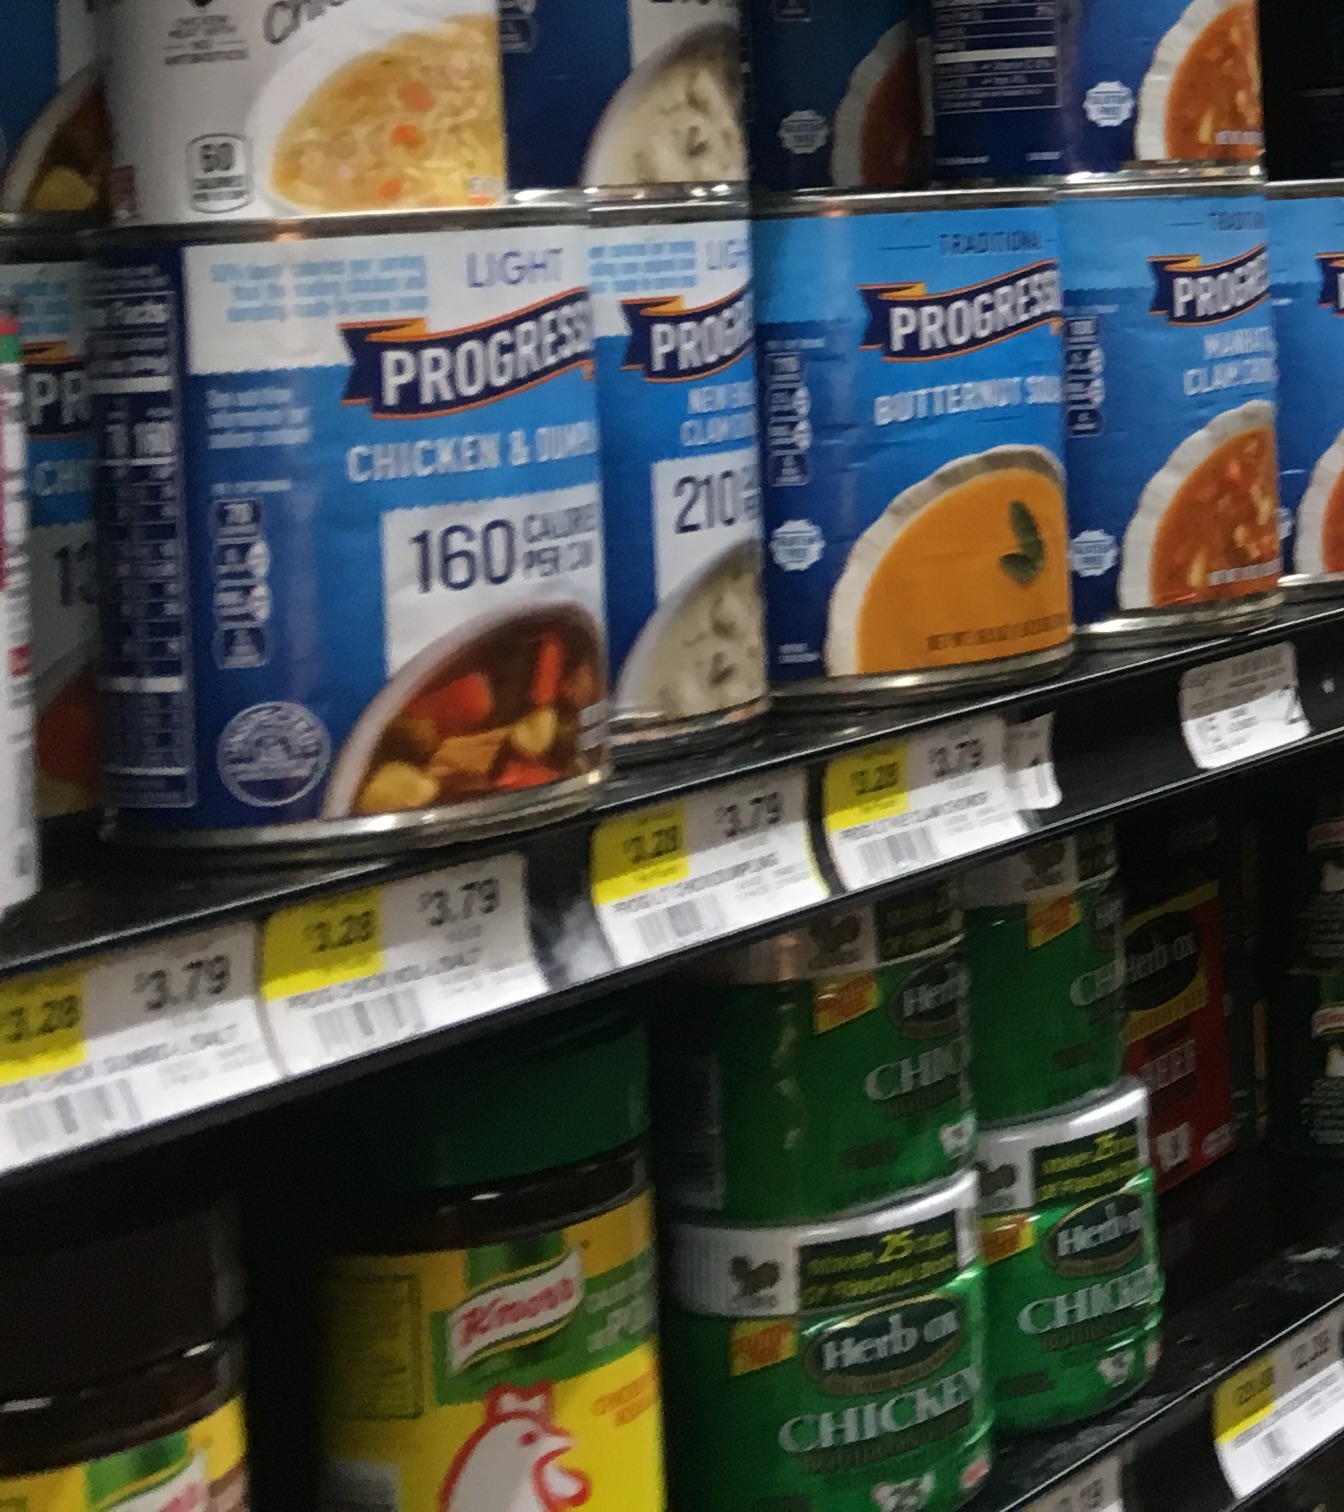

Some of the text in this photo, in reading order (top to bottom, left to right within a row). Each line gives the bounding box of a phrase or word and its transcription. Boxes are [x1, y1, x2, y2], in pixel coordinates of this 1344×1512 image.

[465, 247, 563, 289] LIGHT
[346, 432, 501, 483] CHICKEN
[509, 429, 531, 467] &
[672, 467, 740, 535] 210
[408, 517, 516, 595] 160
